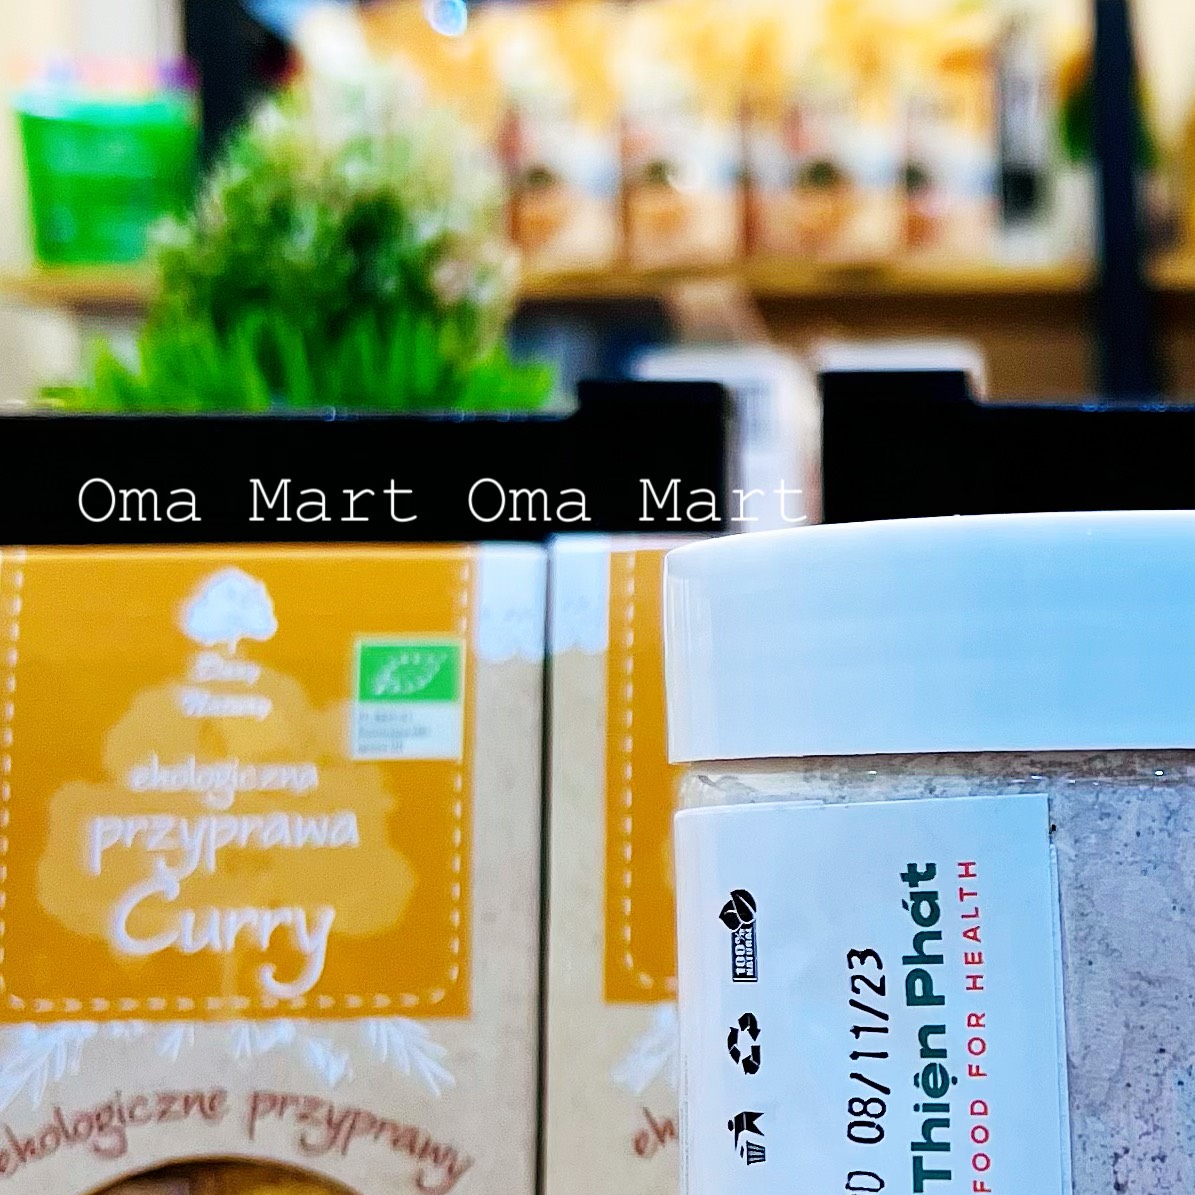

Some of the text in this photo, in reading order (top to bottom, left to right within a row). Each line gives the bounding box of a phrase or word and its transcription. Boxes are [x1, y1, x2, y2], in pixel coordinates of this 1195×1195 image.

[87, 811, 359, 880] przyprawa
[112, 874, 335, 998] Curry
[734, 927, 747, 976] 100%
[846, 946, 891, 1144] 08/11/23
[900, 860, 960, 1193] Thiện Phát
[957, 860, 993, 1193] FOOD FOR HEALTH
